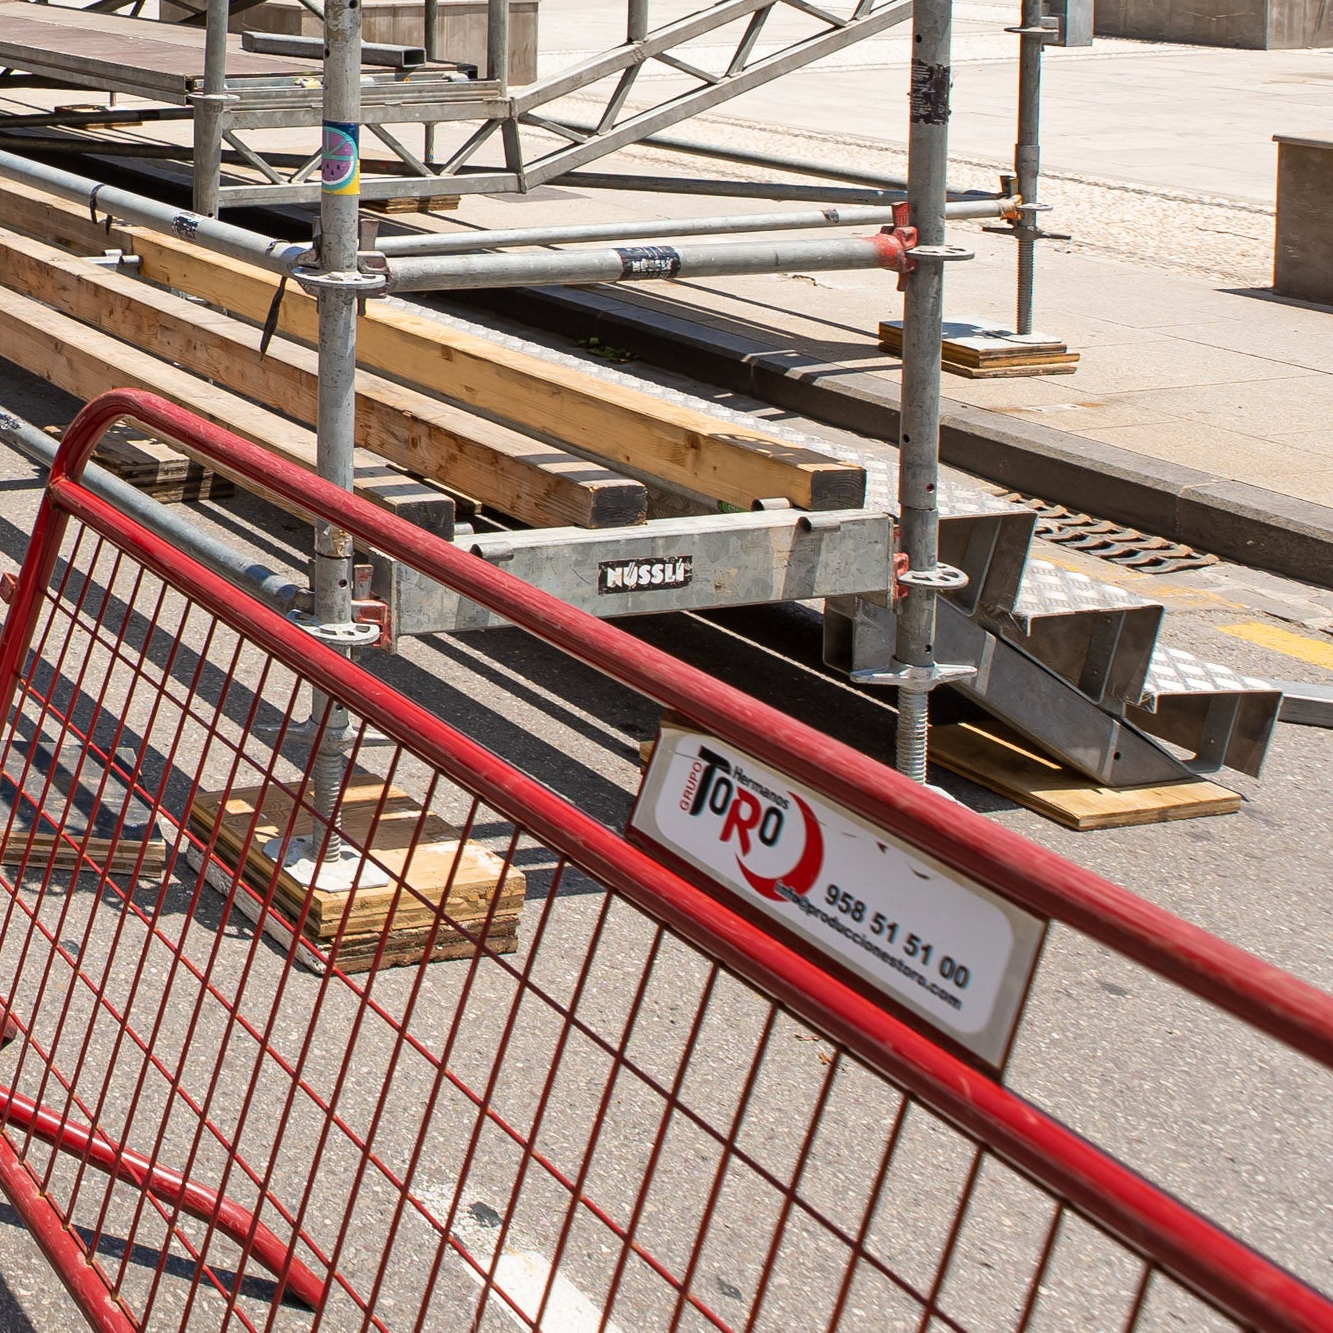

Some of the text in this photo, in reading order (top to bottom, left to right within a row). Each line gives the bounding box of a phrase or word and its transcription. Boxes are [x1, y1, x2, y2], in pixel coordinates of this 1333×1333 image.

[679, 761, 703, 812] GRUPO
[733, 766, 790, 810] Hermanos
[773, 879, 964, 1011] info@produccionestoro.com
[824, 883, 971, 990] 958 51 51 00
